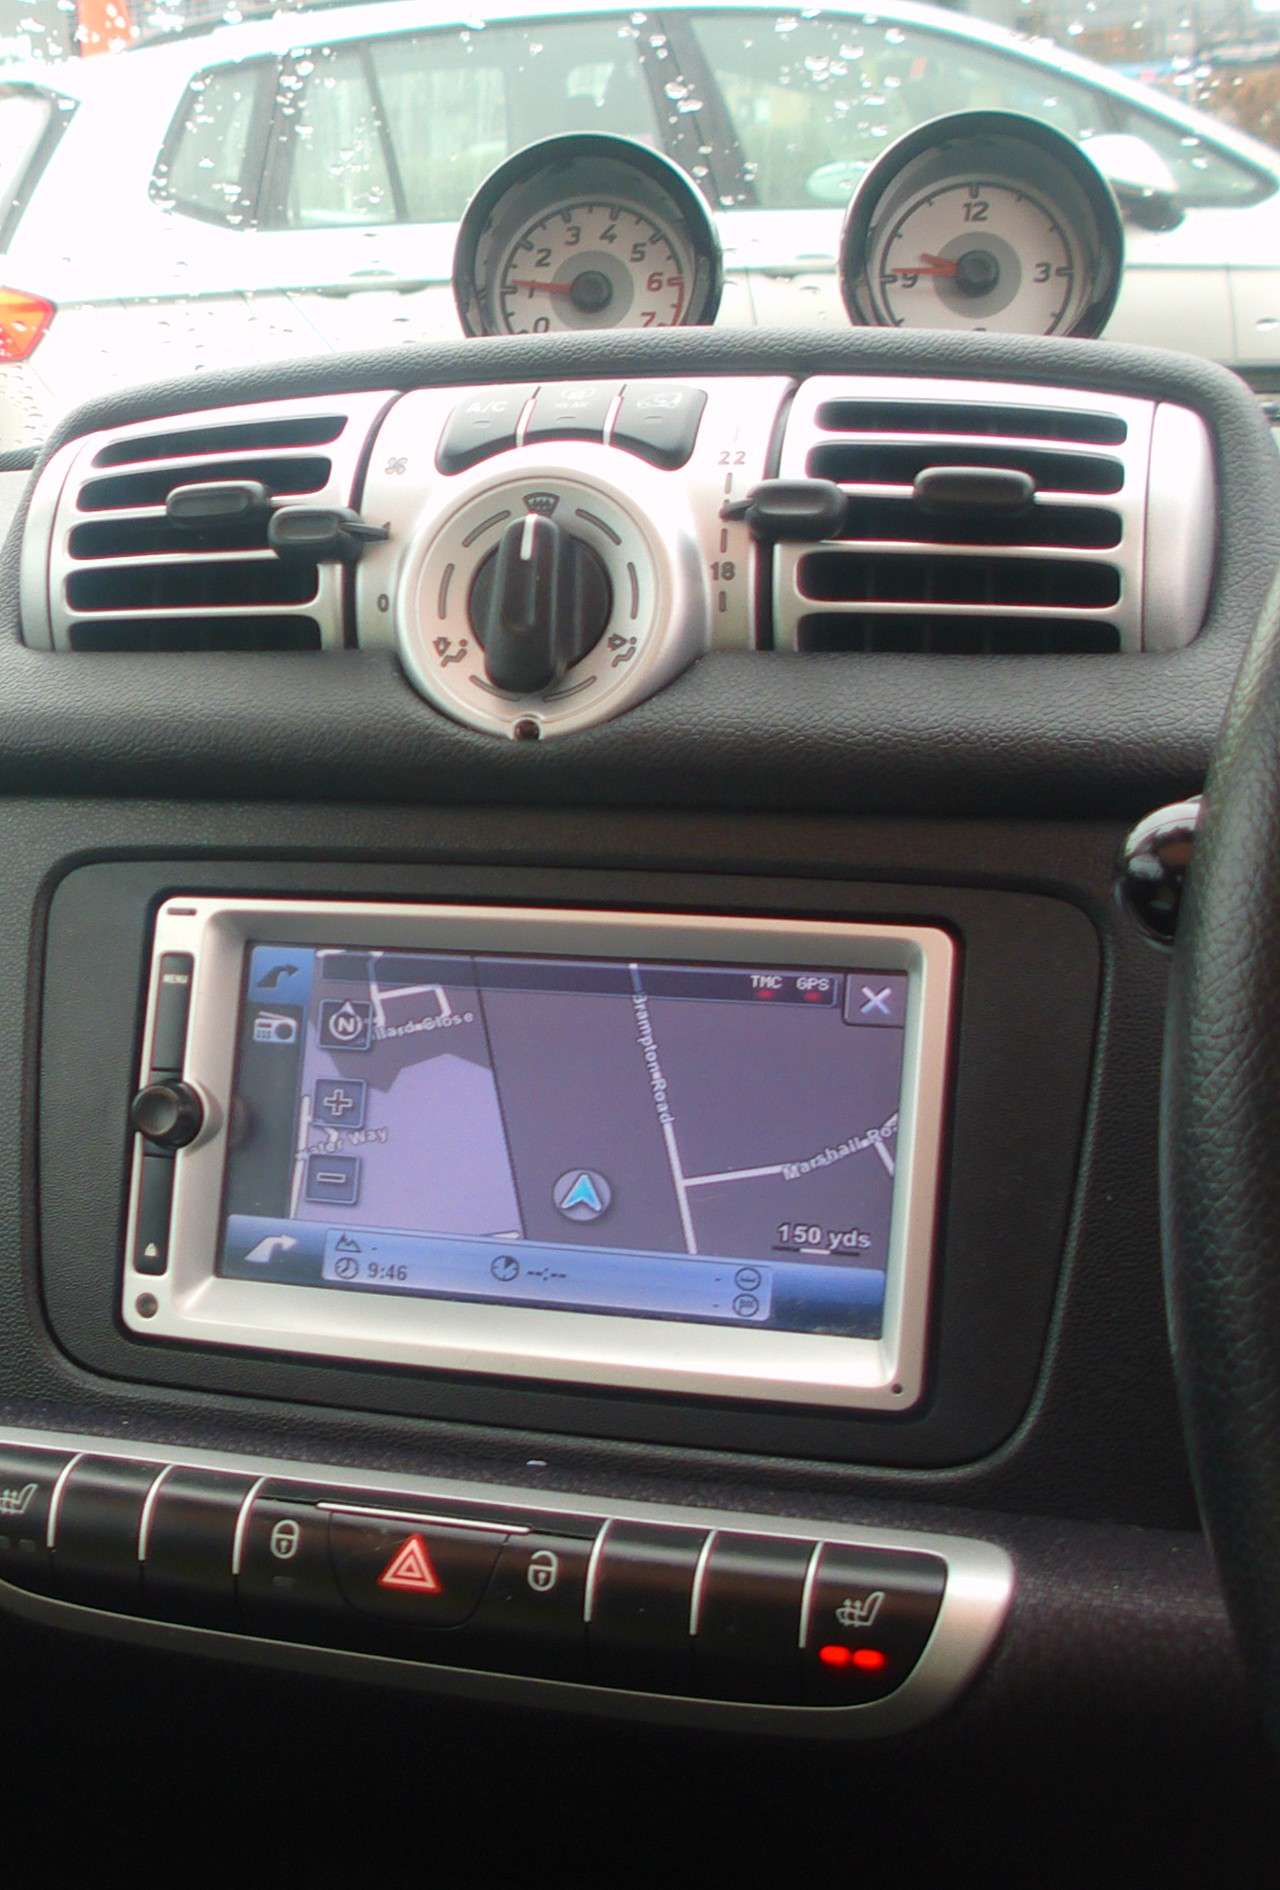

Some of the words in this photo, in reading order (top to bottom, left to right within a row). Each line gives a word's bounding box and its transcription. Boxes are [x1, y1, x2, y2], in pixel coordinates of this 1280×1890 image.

[962, 201, 990, 222] 12
[564, 225, 582, 246] 3
[599, 223, 618, 244] 4
[535, 248, 552, 267] 2
[630, 242, 647, 262] 5
[646, 272, 664, 292] 6
[1033, 261, 1052, 283] 3
[533, 316, 550, 334] 0
[640, 312, 657, 328] 7
[467, 400, 508, 413] A/C
[718, 450, 747, 465] 22
[710, 560, 736, 581] 18
[376, 593, 390, 613] 0
[750, 974, 783, 989] TMC
[796, 977, 830, 991] GPS
[650, 1077, 676, 1124] Road
[348, 1127, 388, 1145] Way
[778, 1223, 822, 1244] 150
[828, 1229, 872, 1250] yds
[366, 1262, 408, 1282] 9:46
